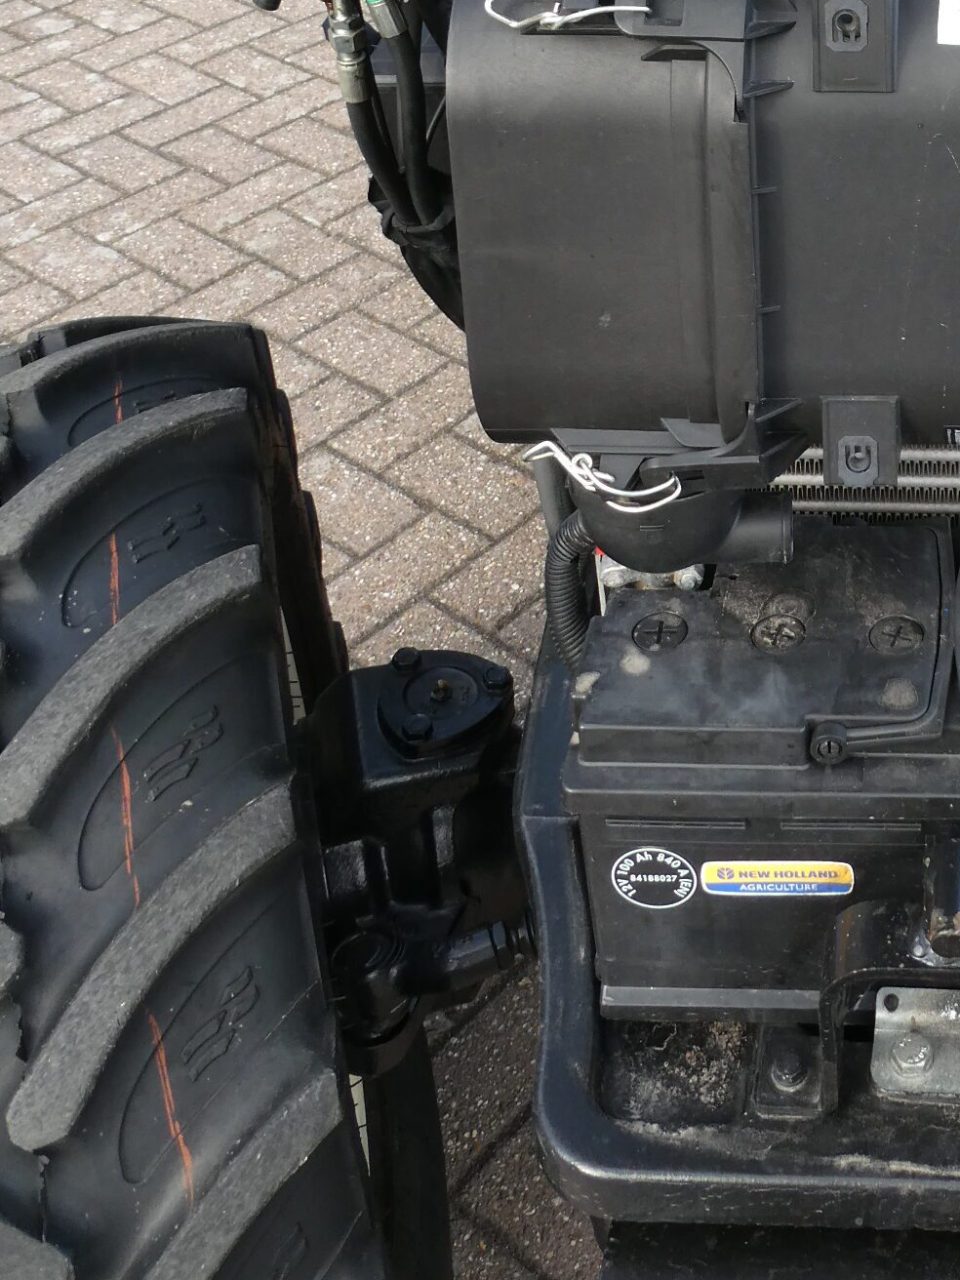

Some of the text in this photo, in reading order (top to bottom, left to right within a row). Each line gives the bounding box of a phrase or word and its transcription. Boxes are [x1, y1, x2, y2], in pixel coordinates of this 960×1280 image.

[635, 851, 653, 863] Ah
[656, 853, 681, 868] 840
[617, 858, 634, 875] 100
[677, 869, 690, 877] A
[738, 870, 839, 879] NEW HOLLAND
[617, 878, 636, 897] 12V
[738, 883, 819, 892] AGRICULTURE
